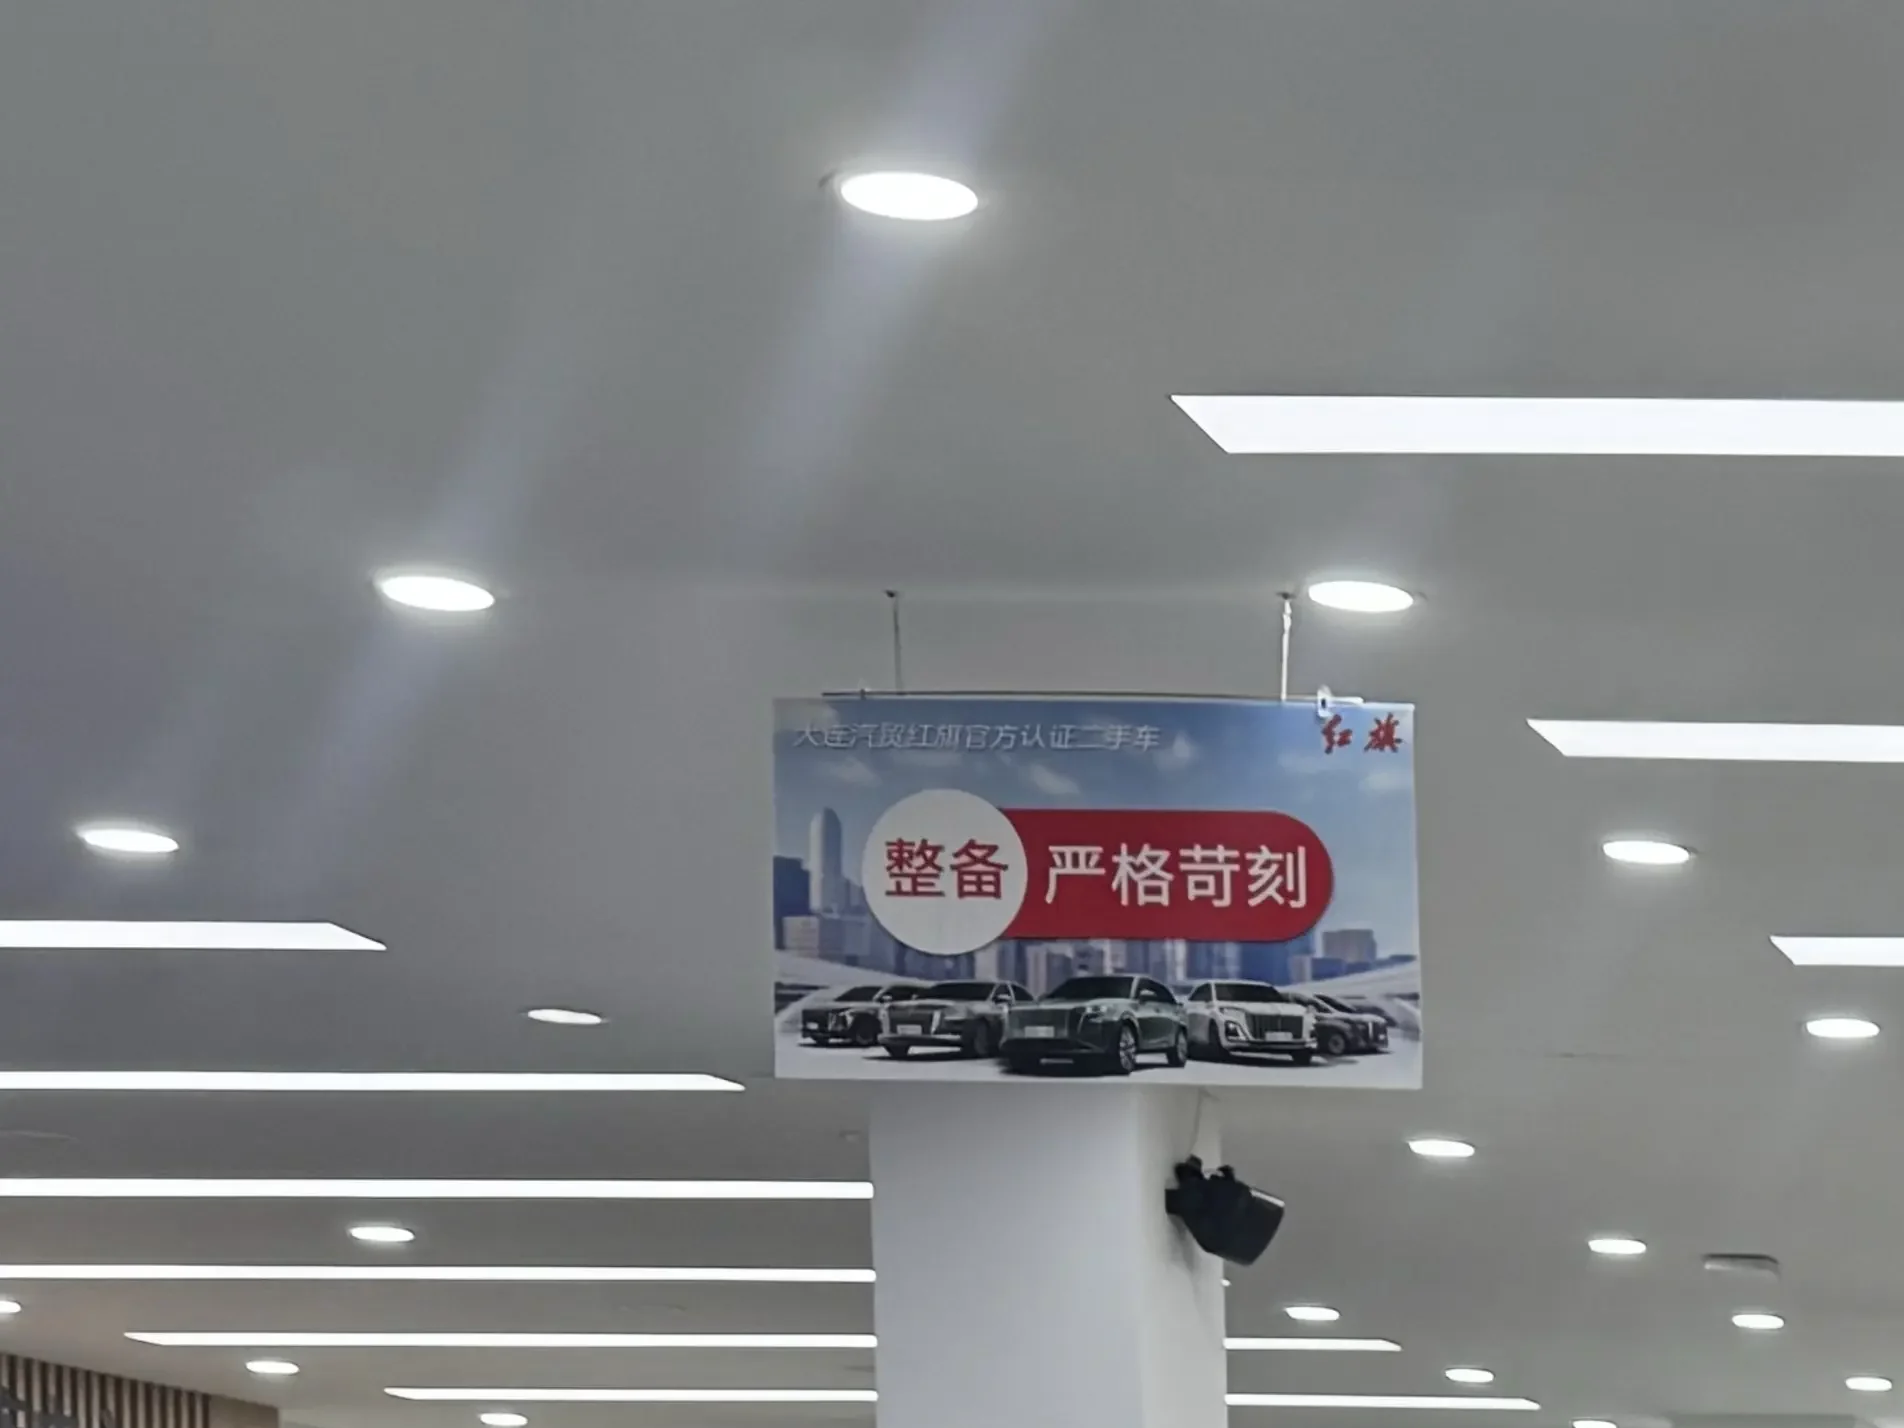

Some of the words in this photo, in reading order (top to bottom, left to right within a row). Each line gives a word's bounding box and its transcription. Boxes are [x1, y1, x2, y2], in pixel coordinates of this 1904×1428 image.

[1321, 712, 1403, 754] 红旗
[884, 838, 1009, 898] 整备
[1044, 843, 1308, 909] 严格苛刻
